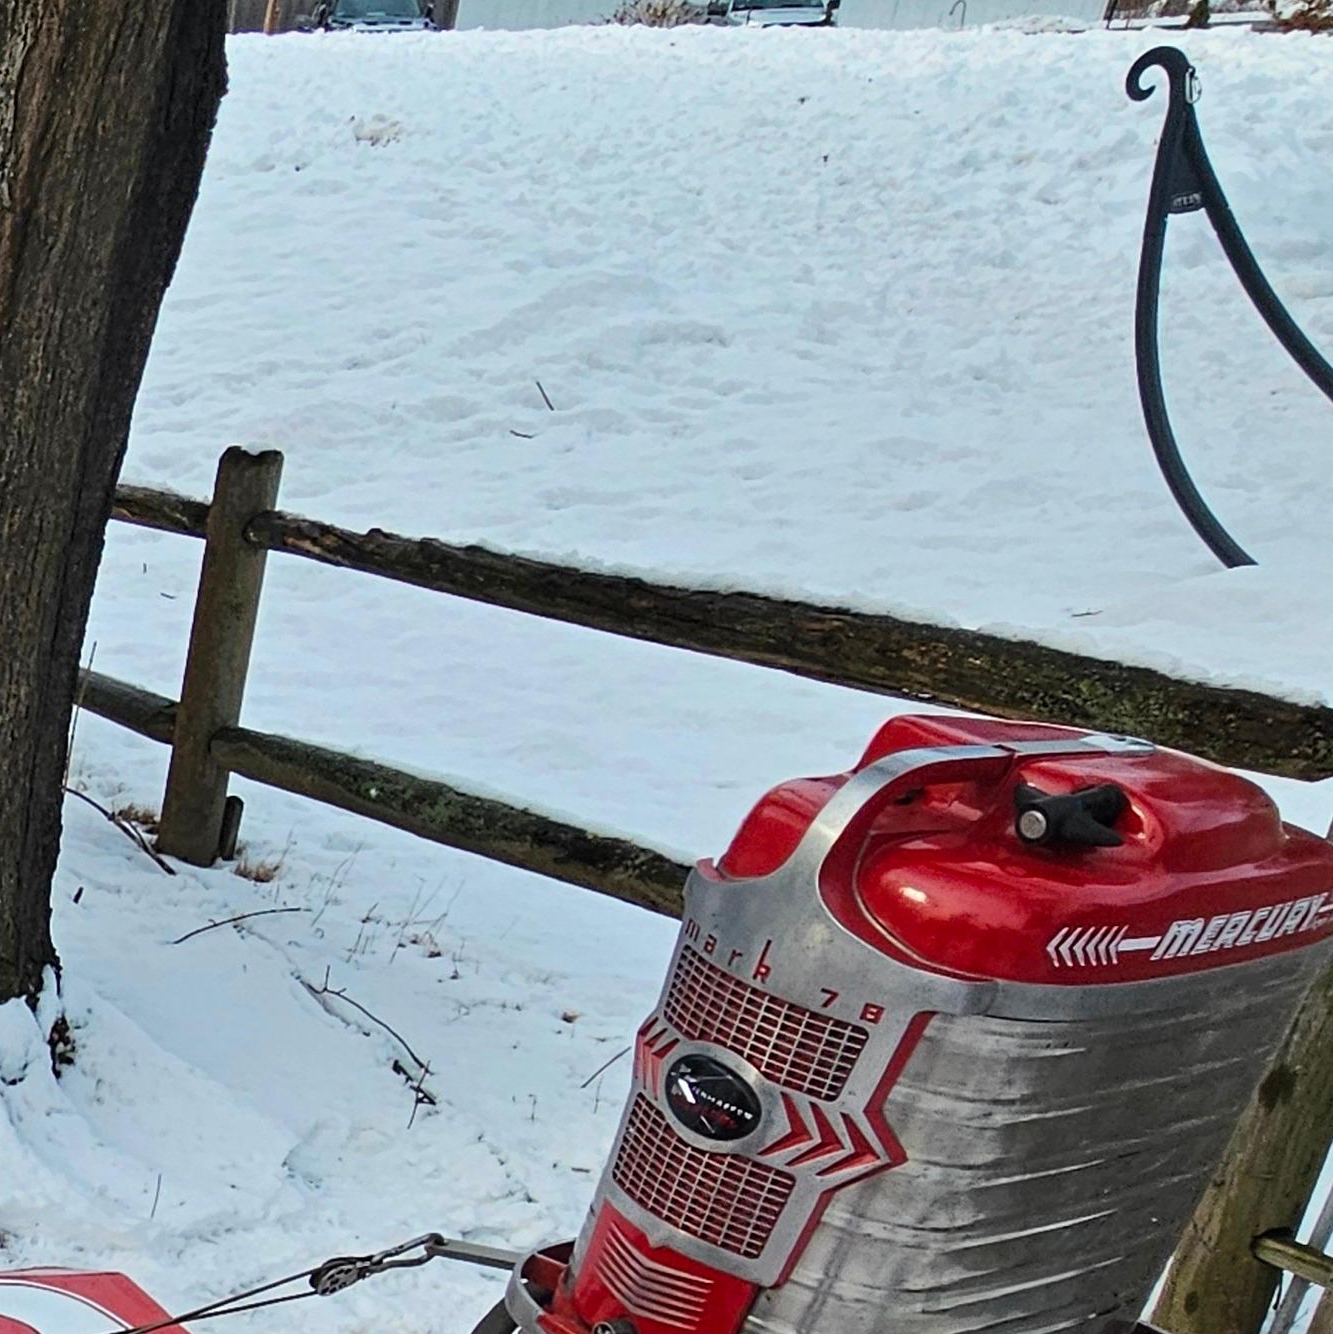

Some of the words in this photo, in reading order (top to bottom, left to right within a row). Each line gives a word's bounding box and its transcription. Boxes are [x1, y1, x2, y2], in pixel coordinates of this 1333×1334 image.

[1150, 892, 1329, 961] MERCURY
[684, 918, 772, 984] mark
[820, 987, 885, 1025] 78
